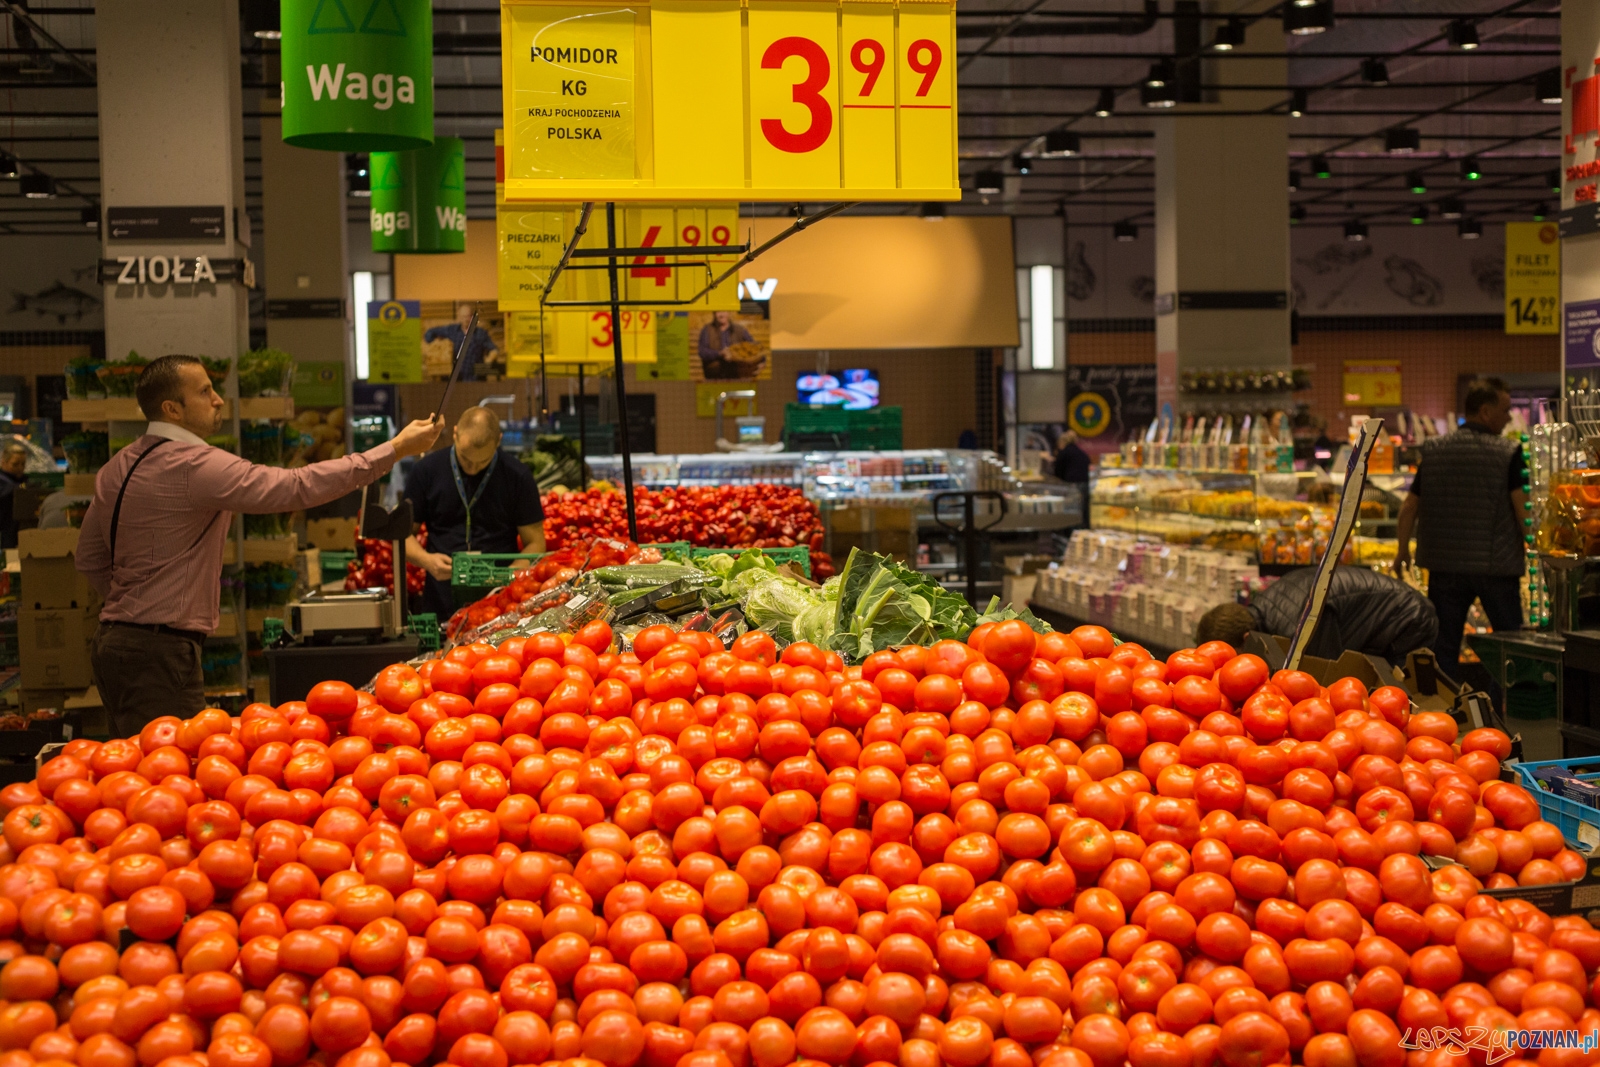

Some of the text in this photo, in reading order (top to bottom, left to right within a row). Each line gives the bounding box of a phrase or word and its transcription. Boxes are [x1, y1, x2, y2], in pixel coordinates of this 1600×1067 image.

[530, 46, 618, 65] POMIDOR
[306, 63, 415, 111] Waga
[561, 79, 587, 97] KG
[760, 36, 833, 154] 3
[528, 108, 621, 119] KRAJ POCHODZENIA
[547, 127, 602, 140] POLSKA
[370, 206, 410, 237] aga
[507, 234, 560, 243] PIECZARKI
[527, 250, 541, 259] KG
[1516, 254, 1550, 266] FILET
[117, 254, 217, 284] ZIOŁA
[1510, 297, 1556, 325] 14 99
[592, 311, 613, 347] 3
